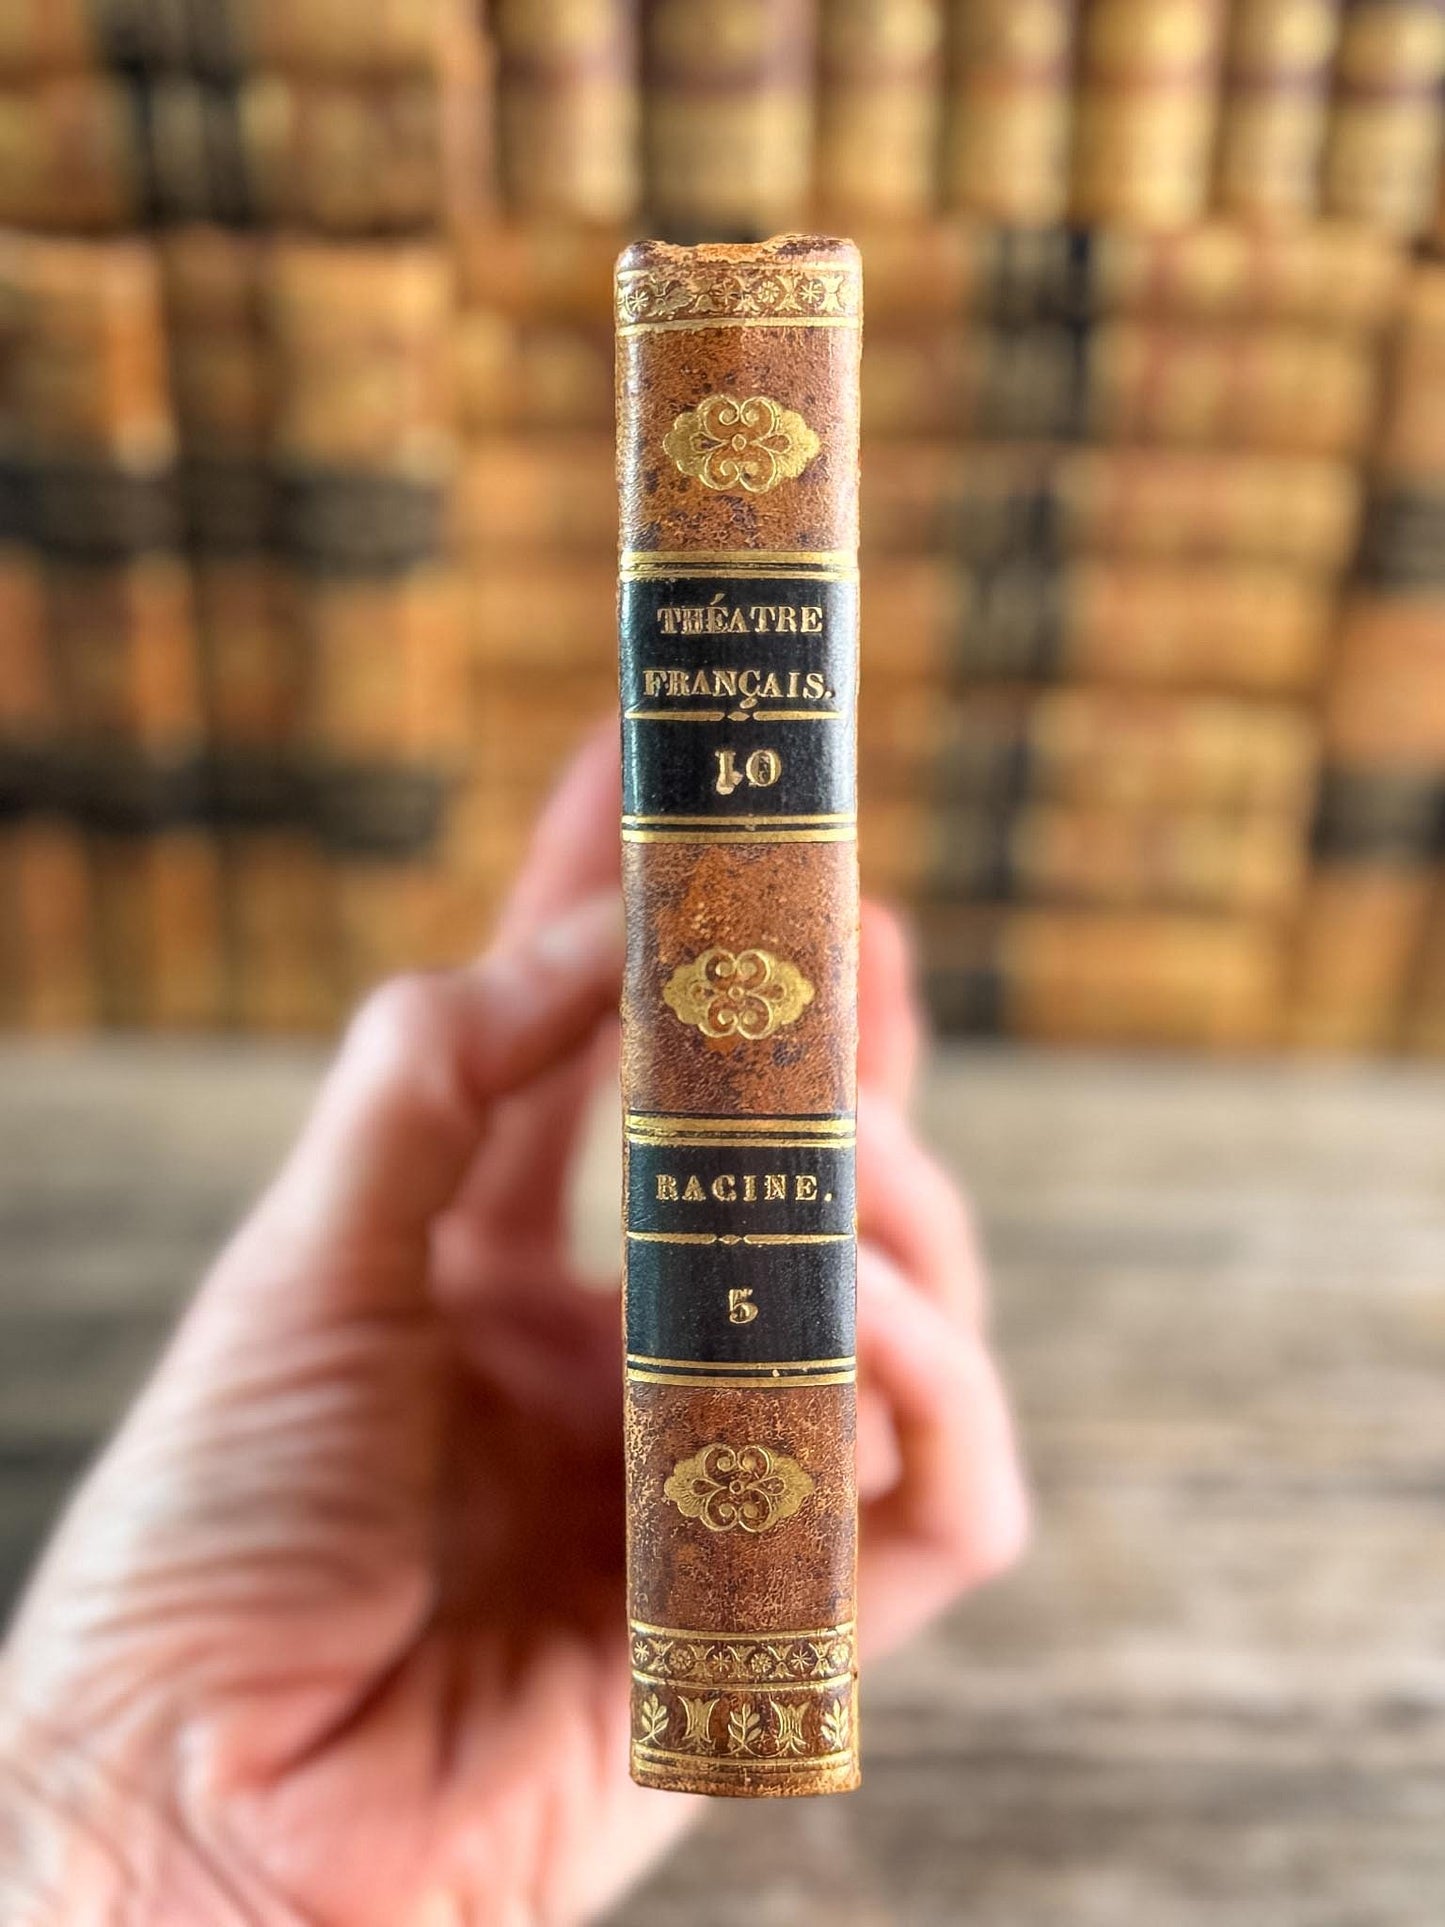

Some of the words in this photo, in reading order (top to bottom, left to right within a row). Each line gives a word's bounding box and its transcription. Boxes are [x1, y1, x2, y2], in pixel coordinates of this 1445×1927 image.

[657, 593, 823, 634] THÉATRE
[643, 670, 834, 709] FRANÇAIS.
[714, 750, 782, 795] 10
[656, 1174, 832, 1201] RACINE.
[729, 1289, 758, 1324] 5
